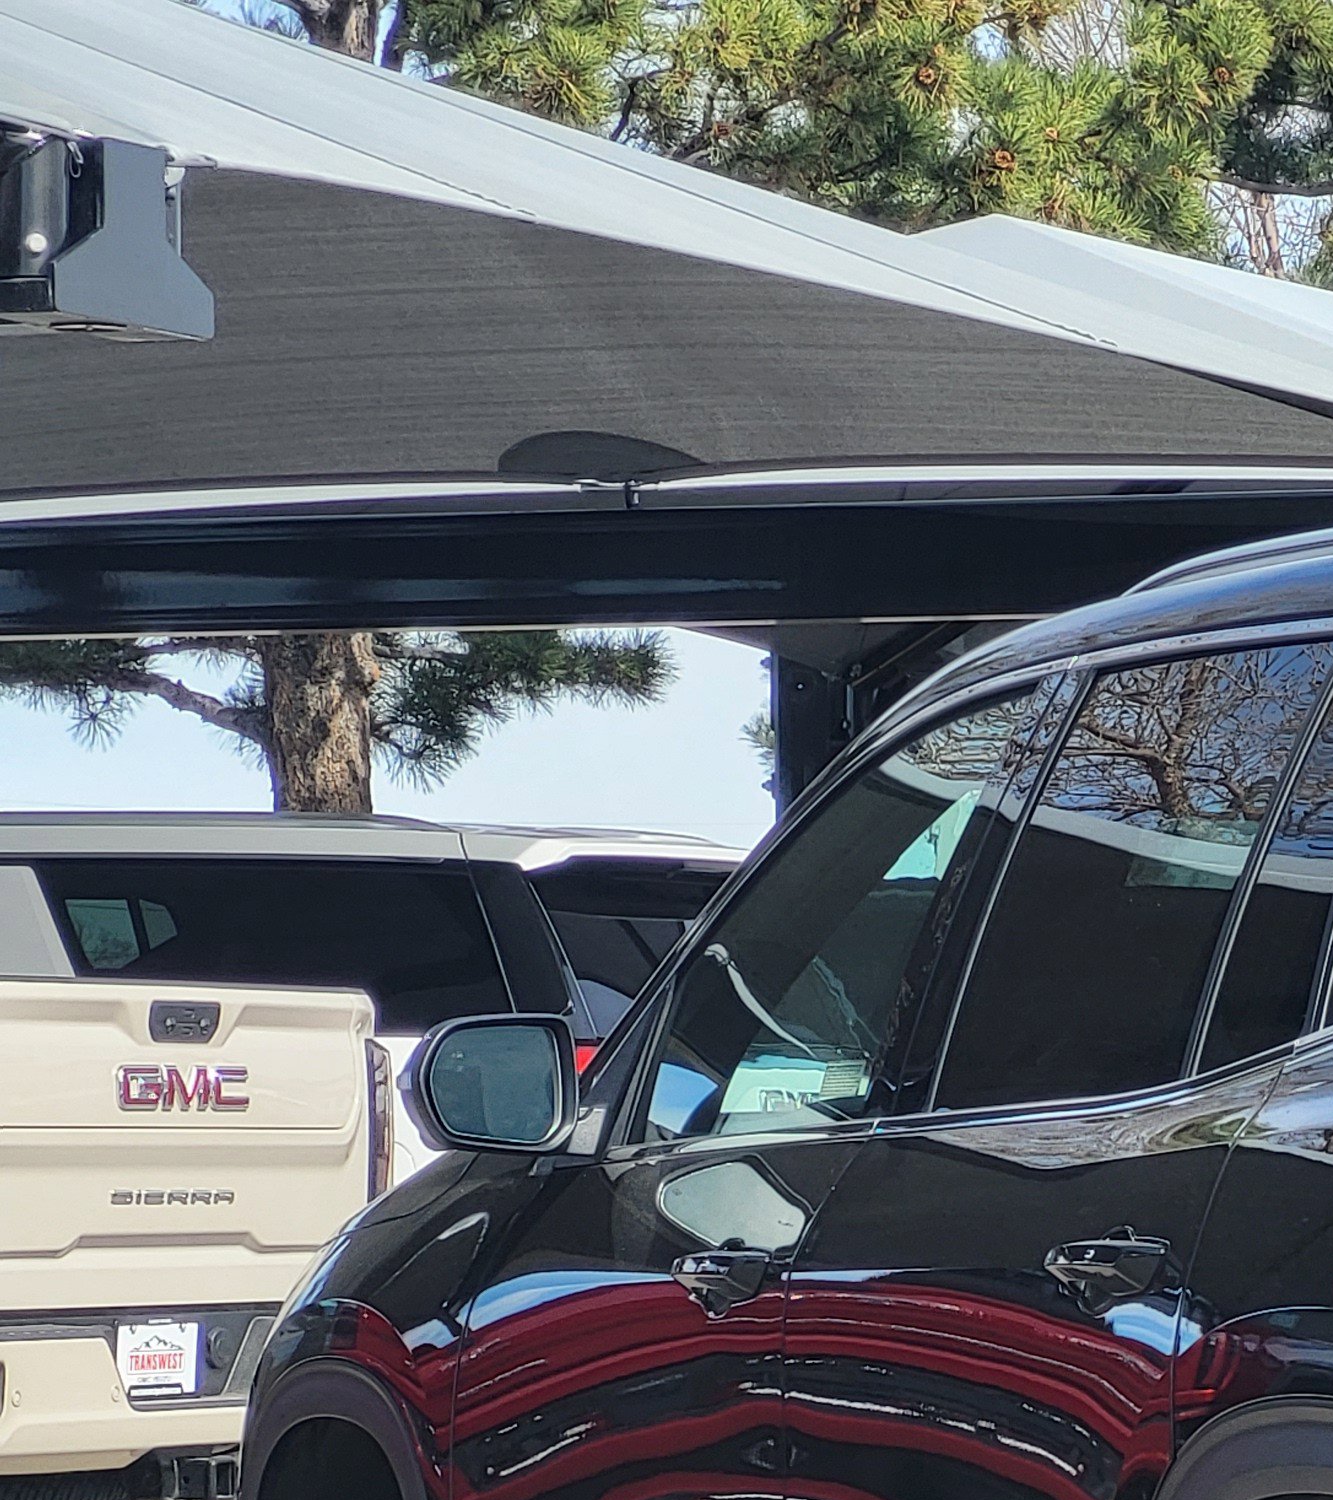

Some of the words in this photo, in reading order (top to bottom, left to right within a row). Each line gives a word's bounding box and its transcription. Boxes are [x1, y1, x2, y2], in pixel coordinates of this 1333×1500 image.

[117, 1064, 250, 1112] GMC
[111, 1189, 235, 1205] SIERRA
[129, 1352, 185, 1371] TRANSWEST
